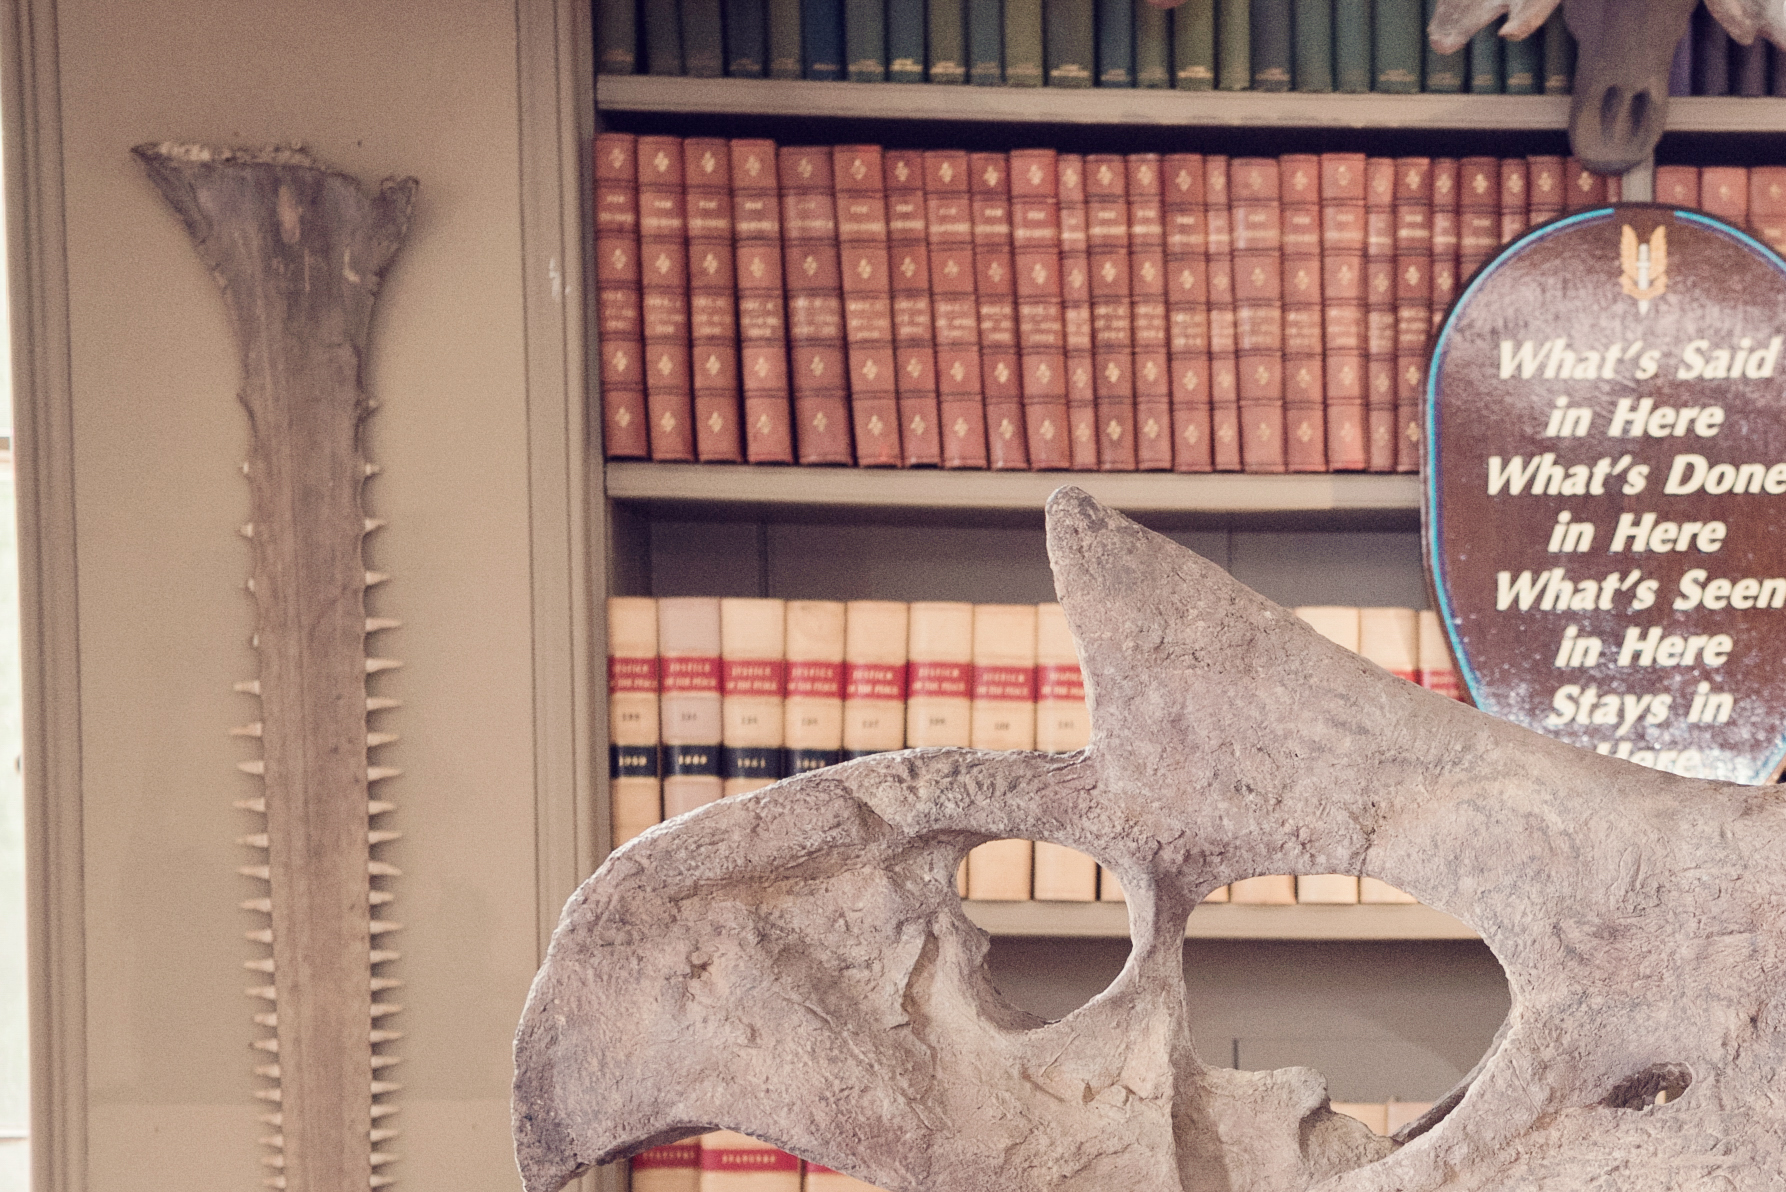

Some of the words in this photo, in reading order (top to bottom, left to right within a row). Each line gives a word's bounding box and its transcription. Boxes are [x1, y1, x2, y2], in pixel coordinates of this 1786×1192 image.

[1500, 337, 1661, 379] What's
[1676, 335, 1783, 380] Said
[1546, 396, 1592, 437] in
[1608, 398, 1725, 437] Here
[1487, 453, 1650, 495] What's
[1549, 511, 1595, 552] in
[1610, 513, 1727, 552] Here
[1496, 568, 1659, 610] What's
[1555, 625, 1602, 667] in
[1617, 627, 1733, 667] Here
[1548, 685, 1672, 737] Stays
[1687, 681, 1734, 723] in
